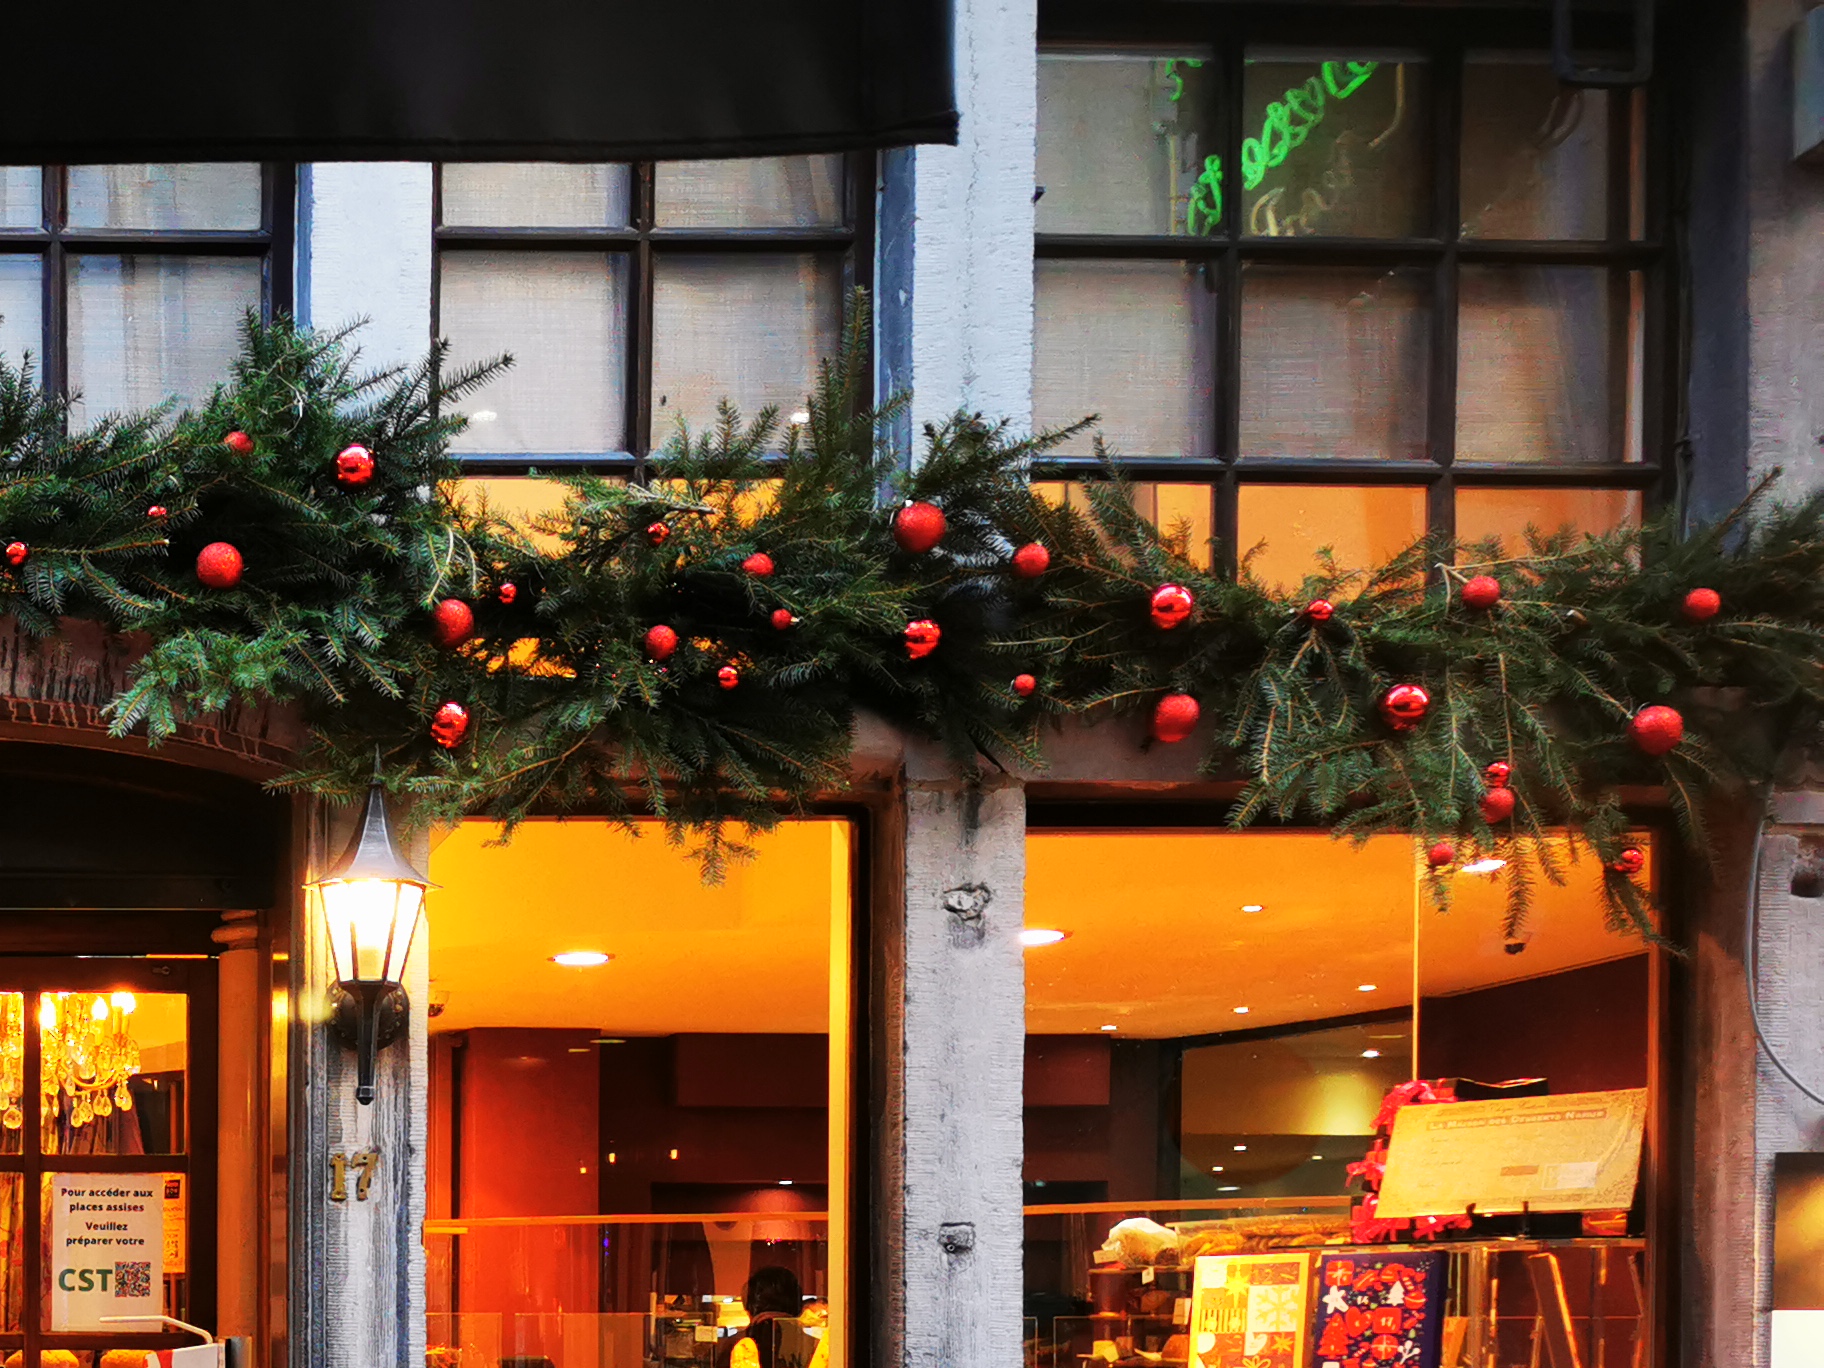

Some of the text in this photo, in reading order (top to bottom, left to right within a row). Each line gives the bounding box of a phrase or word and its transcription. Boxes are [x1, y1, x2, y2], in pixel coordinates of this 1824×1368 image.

[330, 1152, 378, 1202] 17
[61, 1188, 85, 1197] Pour
[88, 1187, 130, 1197] accéder
[69, 1202, 144, 1213] places assises
[85, 1221, 128, 1231] Veuillez
[66, 1236, 112, 1247] préparer
[58, 1268, 113, 1292] CST
